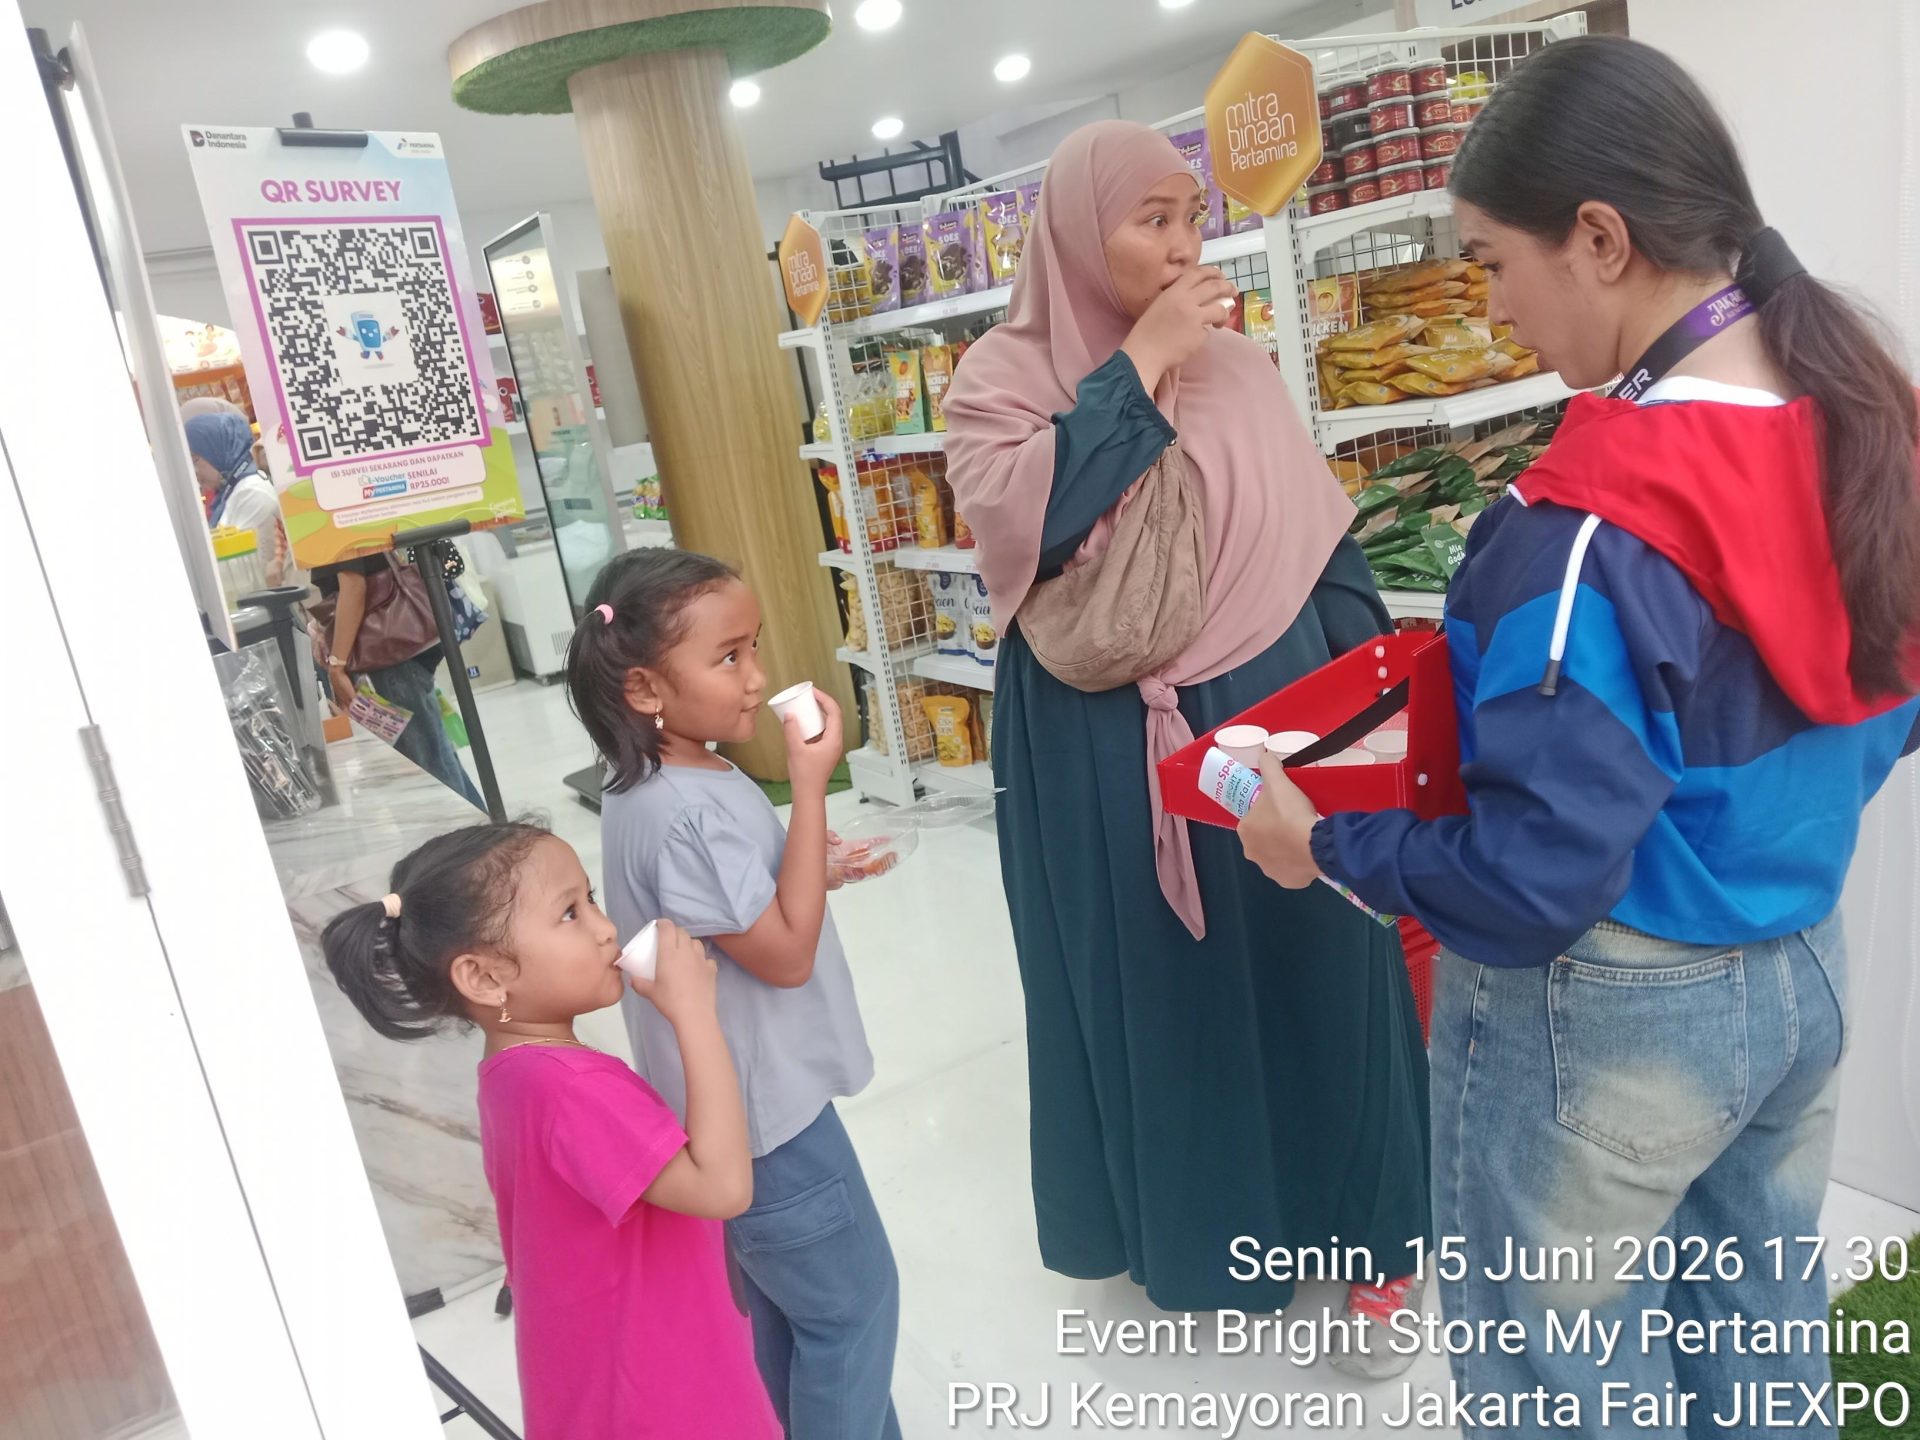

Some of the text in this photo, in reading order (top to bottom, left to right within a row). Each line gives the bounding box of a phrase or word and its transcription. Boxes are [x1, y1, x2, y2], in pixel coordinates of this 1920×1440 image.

[1225, 91, 1279, 127] mitra
[207, 139, 247, 149] Indonesia
[1227, 113, 1296, 152] binaan
[1230, 140, 1298, 173] Pertamina
[260, 179, 401, 203] QR SURVEY
[787, 249, 810, 271] mitra
[1615, 368, 1653, 402] ER
[330, 451, 464, 479] ISI SURVEI SEKARANG DAN DAPATKAN
[407, 467, 438, 480] SENILAI
[1239, 779, 1253, 799] Fair
